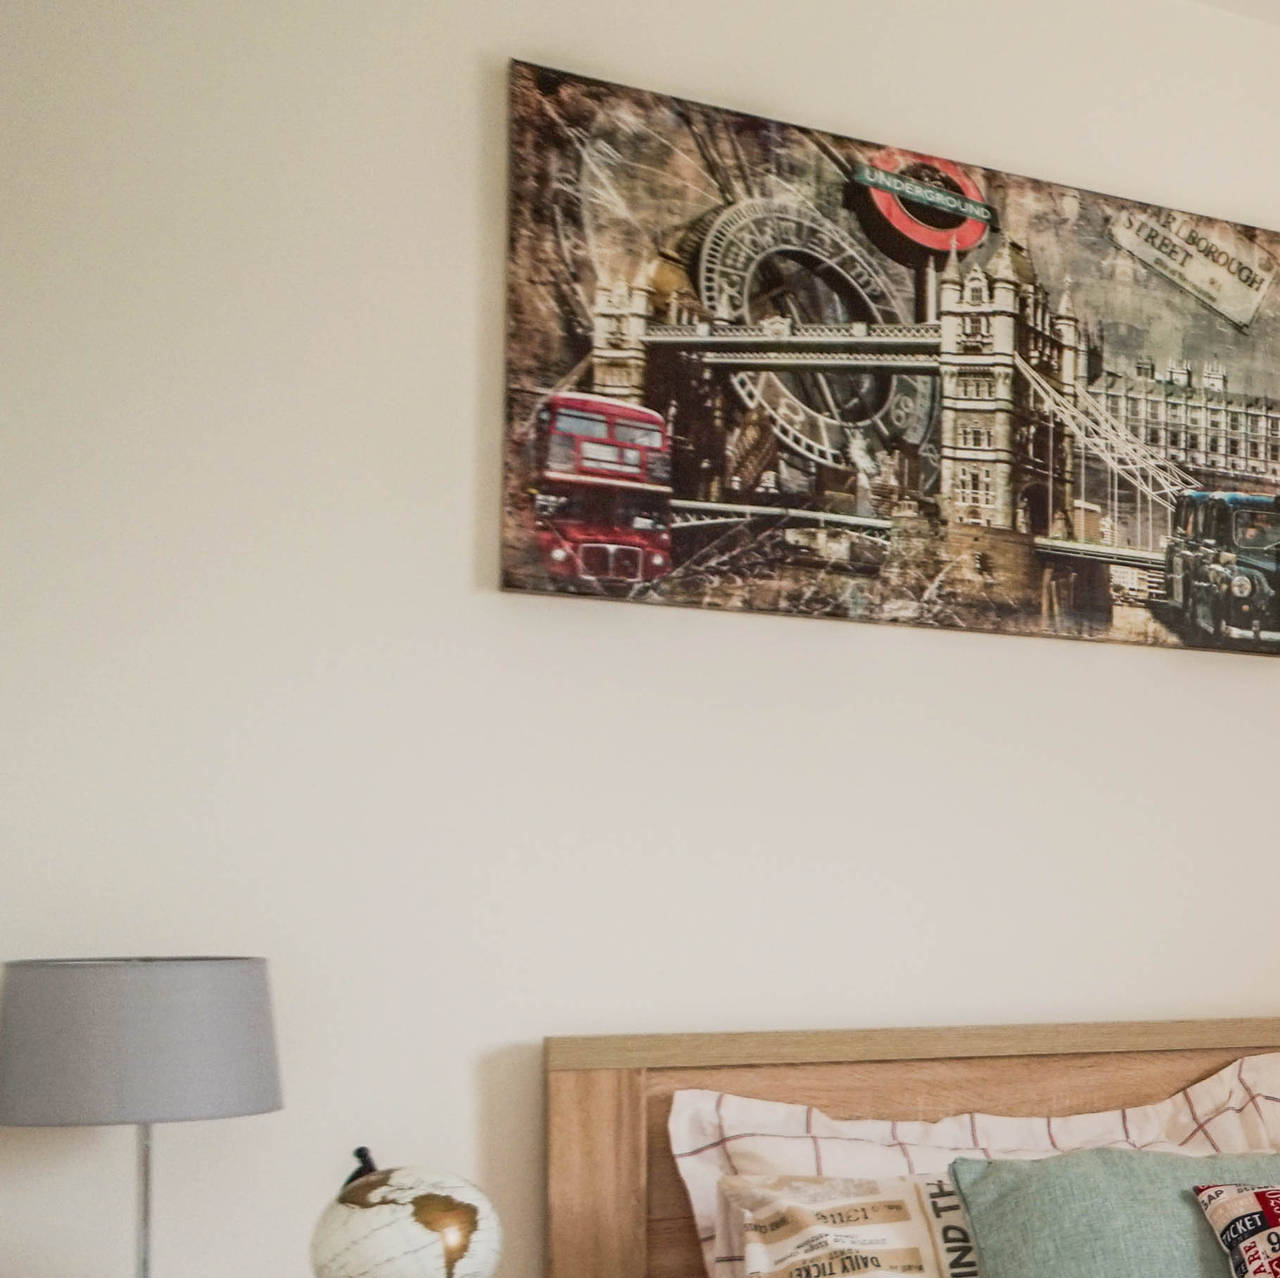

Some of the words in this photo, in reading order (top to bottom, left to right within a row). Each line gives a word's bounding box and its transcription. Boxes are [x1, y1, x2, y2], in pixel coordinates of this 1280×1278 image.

[864, 168, 991, 219] UNDERGROUND
[1123, 215, 1193, 268] STREET
[1148, 206, 1265, 292] ARLBOROUGH
[928, 1178, 961, 1218] TH
[1221, 1215, 1263, 1244] TICKET
[841, 1255, 881, 1274] DAILY
